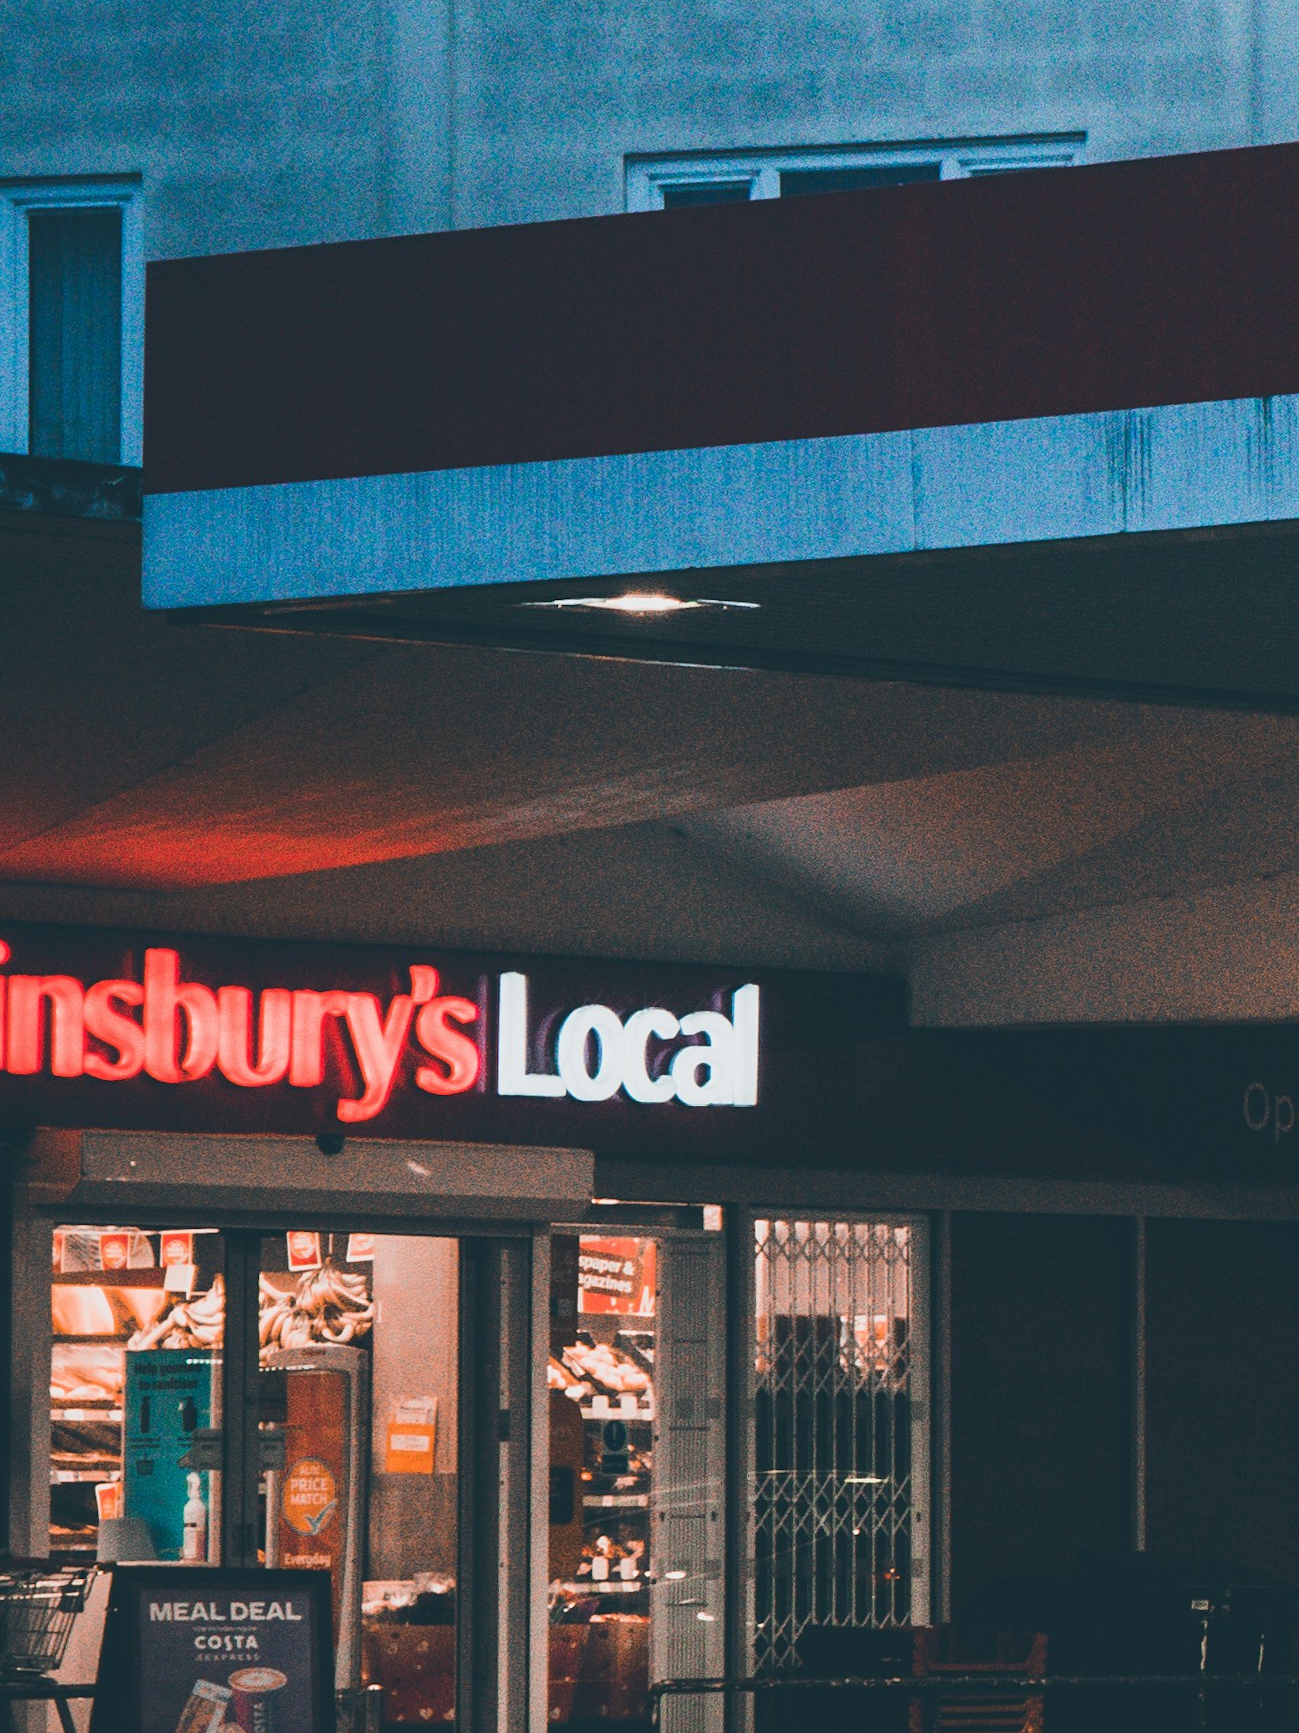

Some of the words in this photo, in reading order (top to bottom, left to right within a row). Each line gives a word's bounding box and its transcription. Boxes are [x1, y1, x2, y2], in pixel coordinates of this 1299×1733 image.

[0, 938, 481, 1123] nsbury's
[497, 971, 761, 1108] Local
[289, 1477, 328, 1491] PRICE
[149, 1601, 227, 1622] MEAL
[229, 1601, 303, 1621] DEAL
[193, 1634, 260, 1652] COSTA
